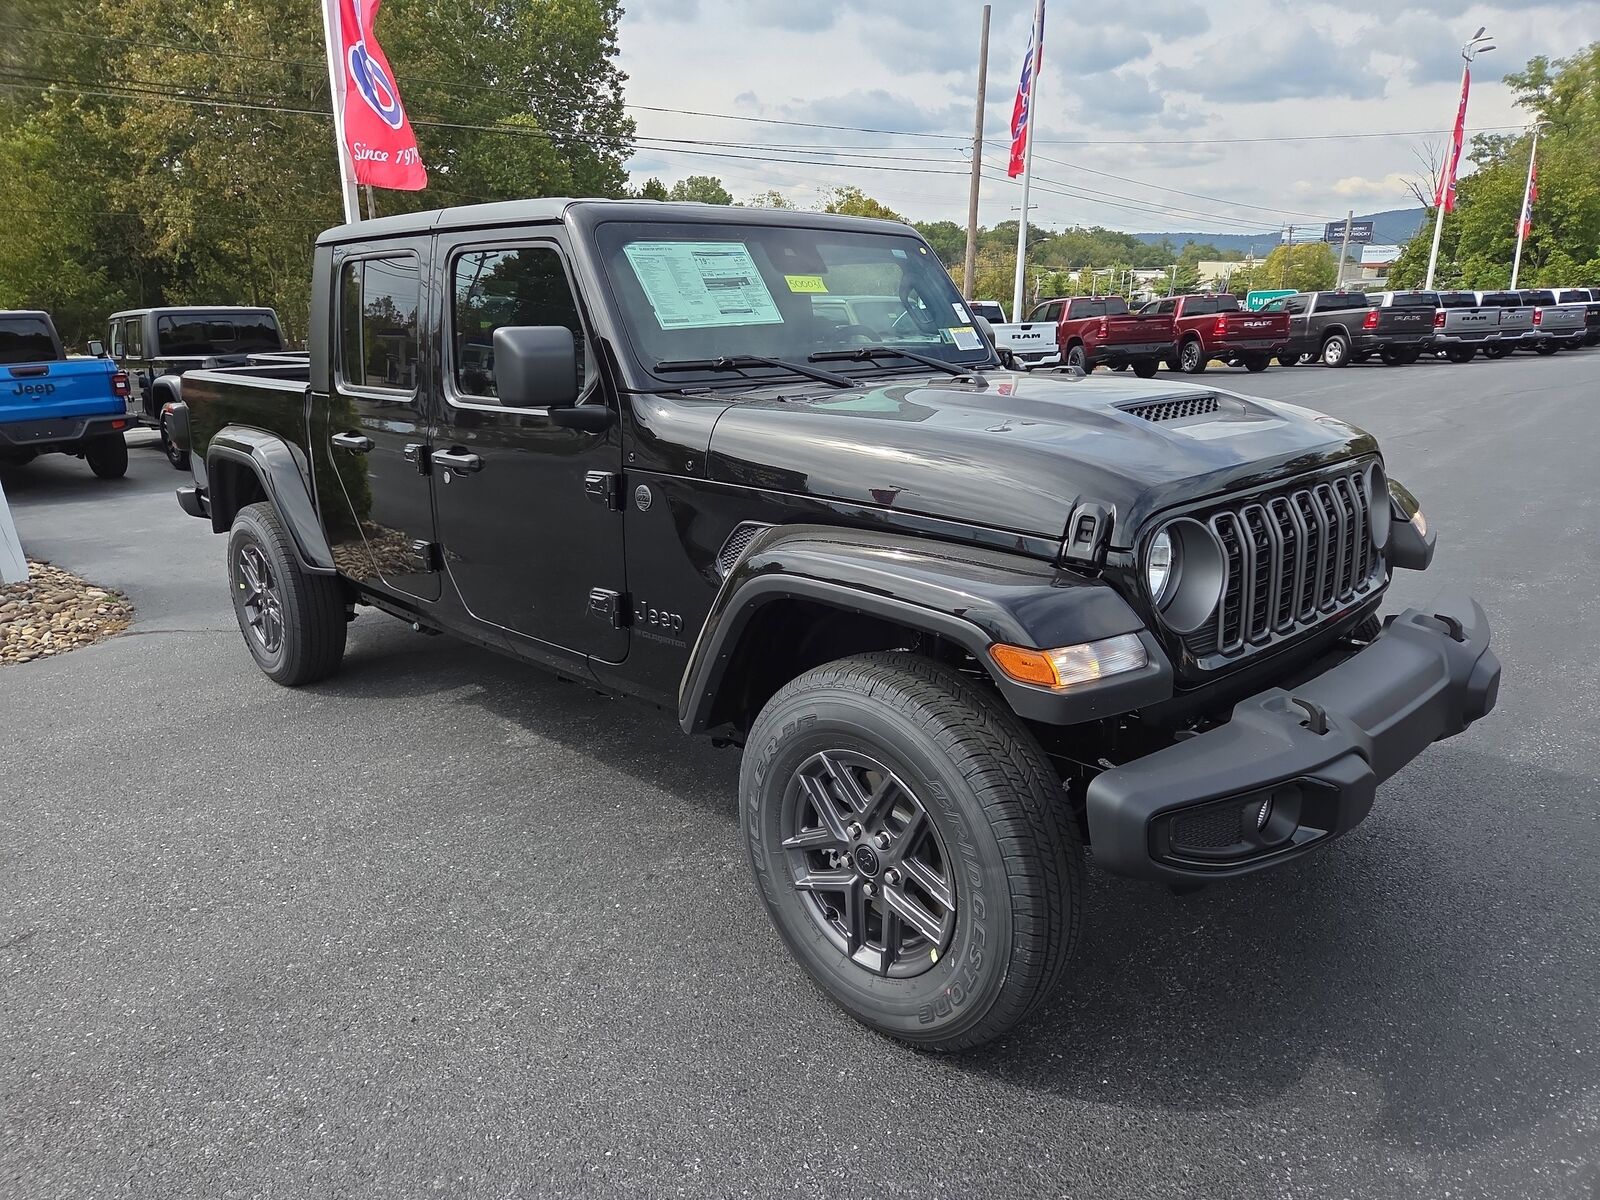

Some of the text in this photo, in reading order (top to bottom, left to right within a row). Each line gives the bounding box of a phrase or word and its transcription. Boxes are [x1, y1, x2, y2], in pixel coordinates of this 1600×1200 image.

[353, 142, 389, 162] Since
[1243, 320, 1273, 328] RAM
[12, 382, 56, 396] Jeep
[634, 600, 684, 637] Jeep
[918, 779, 987, 1025] BRIDGESTONE
